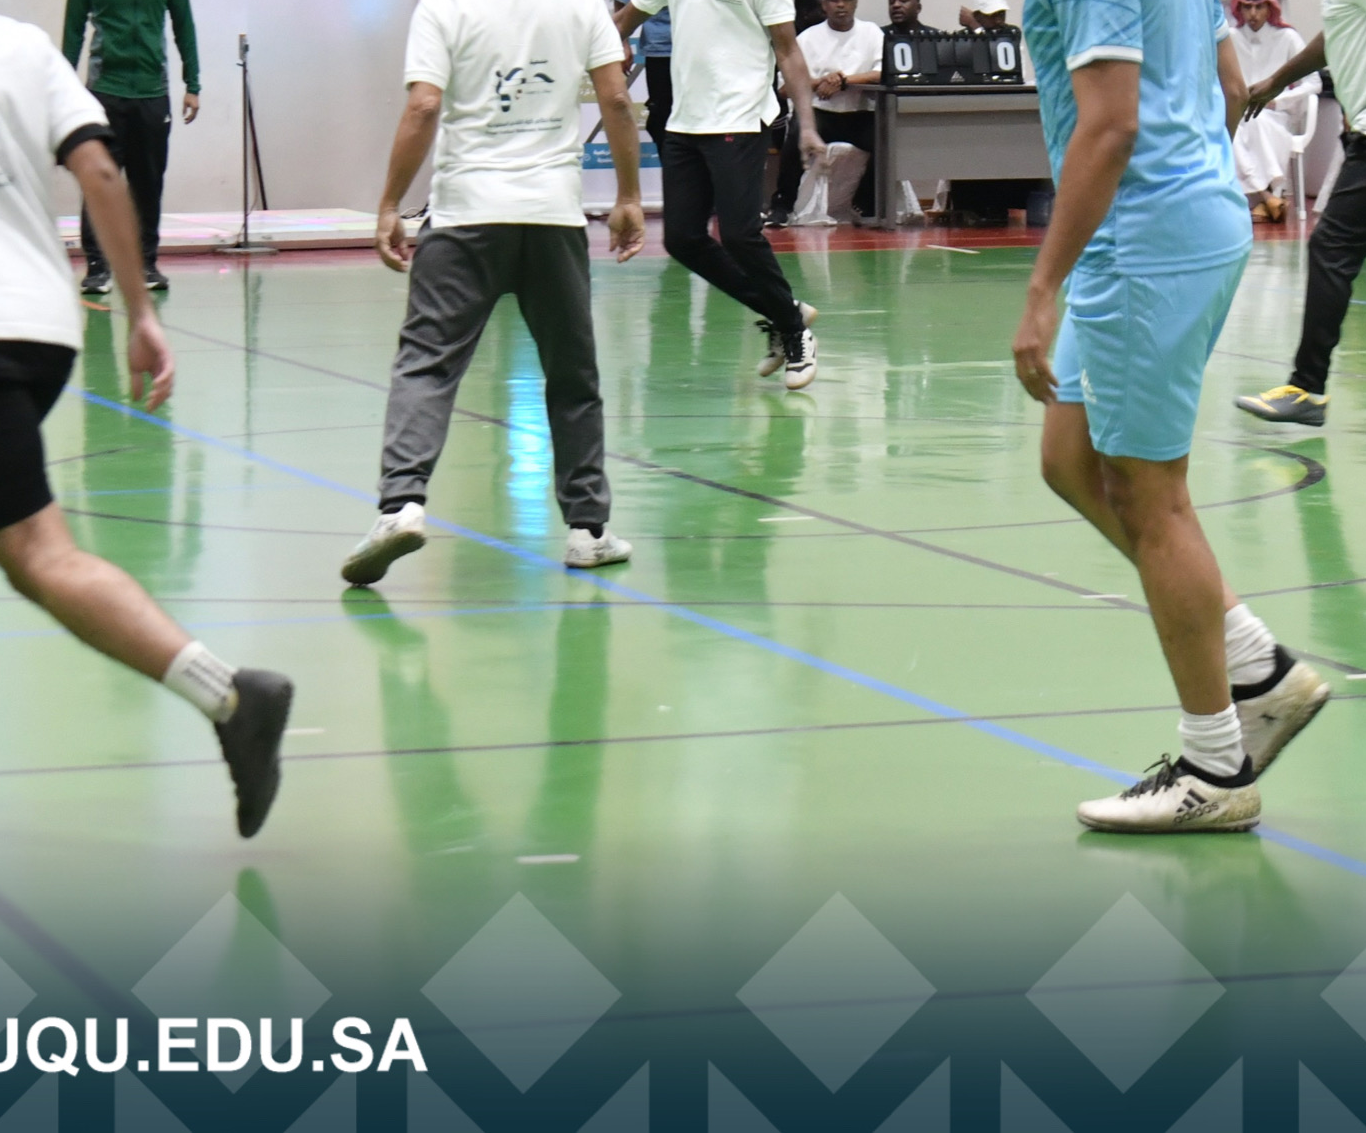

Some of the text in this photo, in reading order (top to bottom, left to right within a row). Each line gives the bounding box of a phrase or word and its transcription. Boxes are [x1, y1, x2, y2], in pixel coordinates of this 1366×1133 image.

[893, 42, 914, 72] 0
[996, 41, 1016, 71] 0
[1173, 801, 1220, 825] adidas
